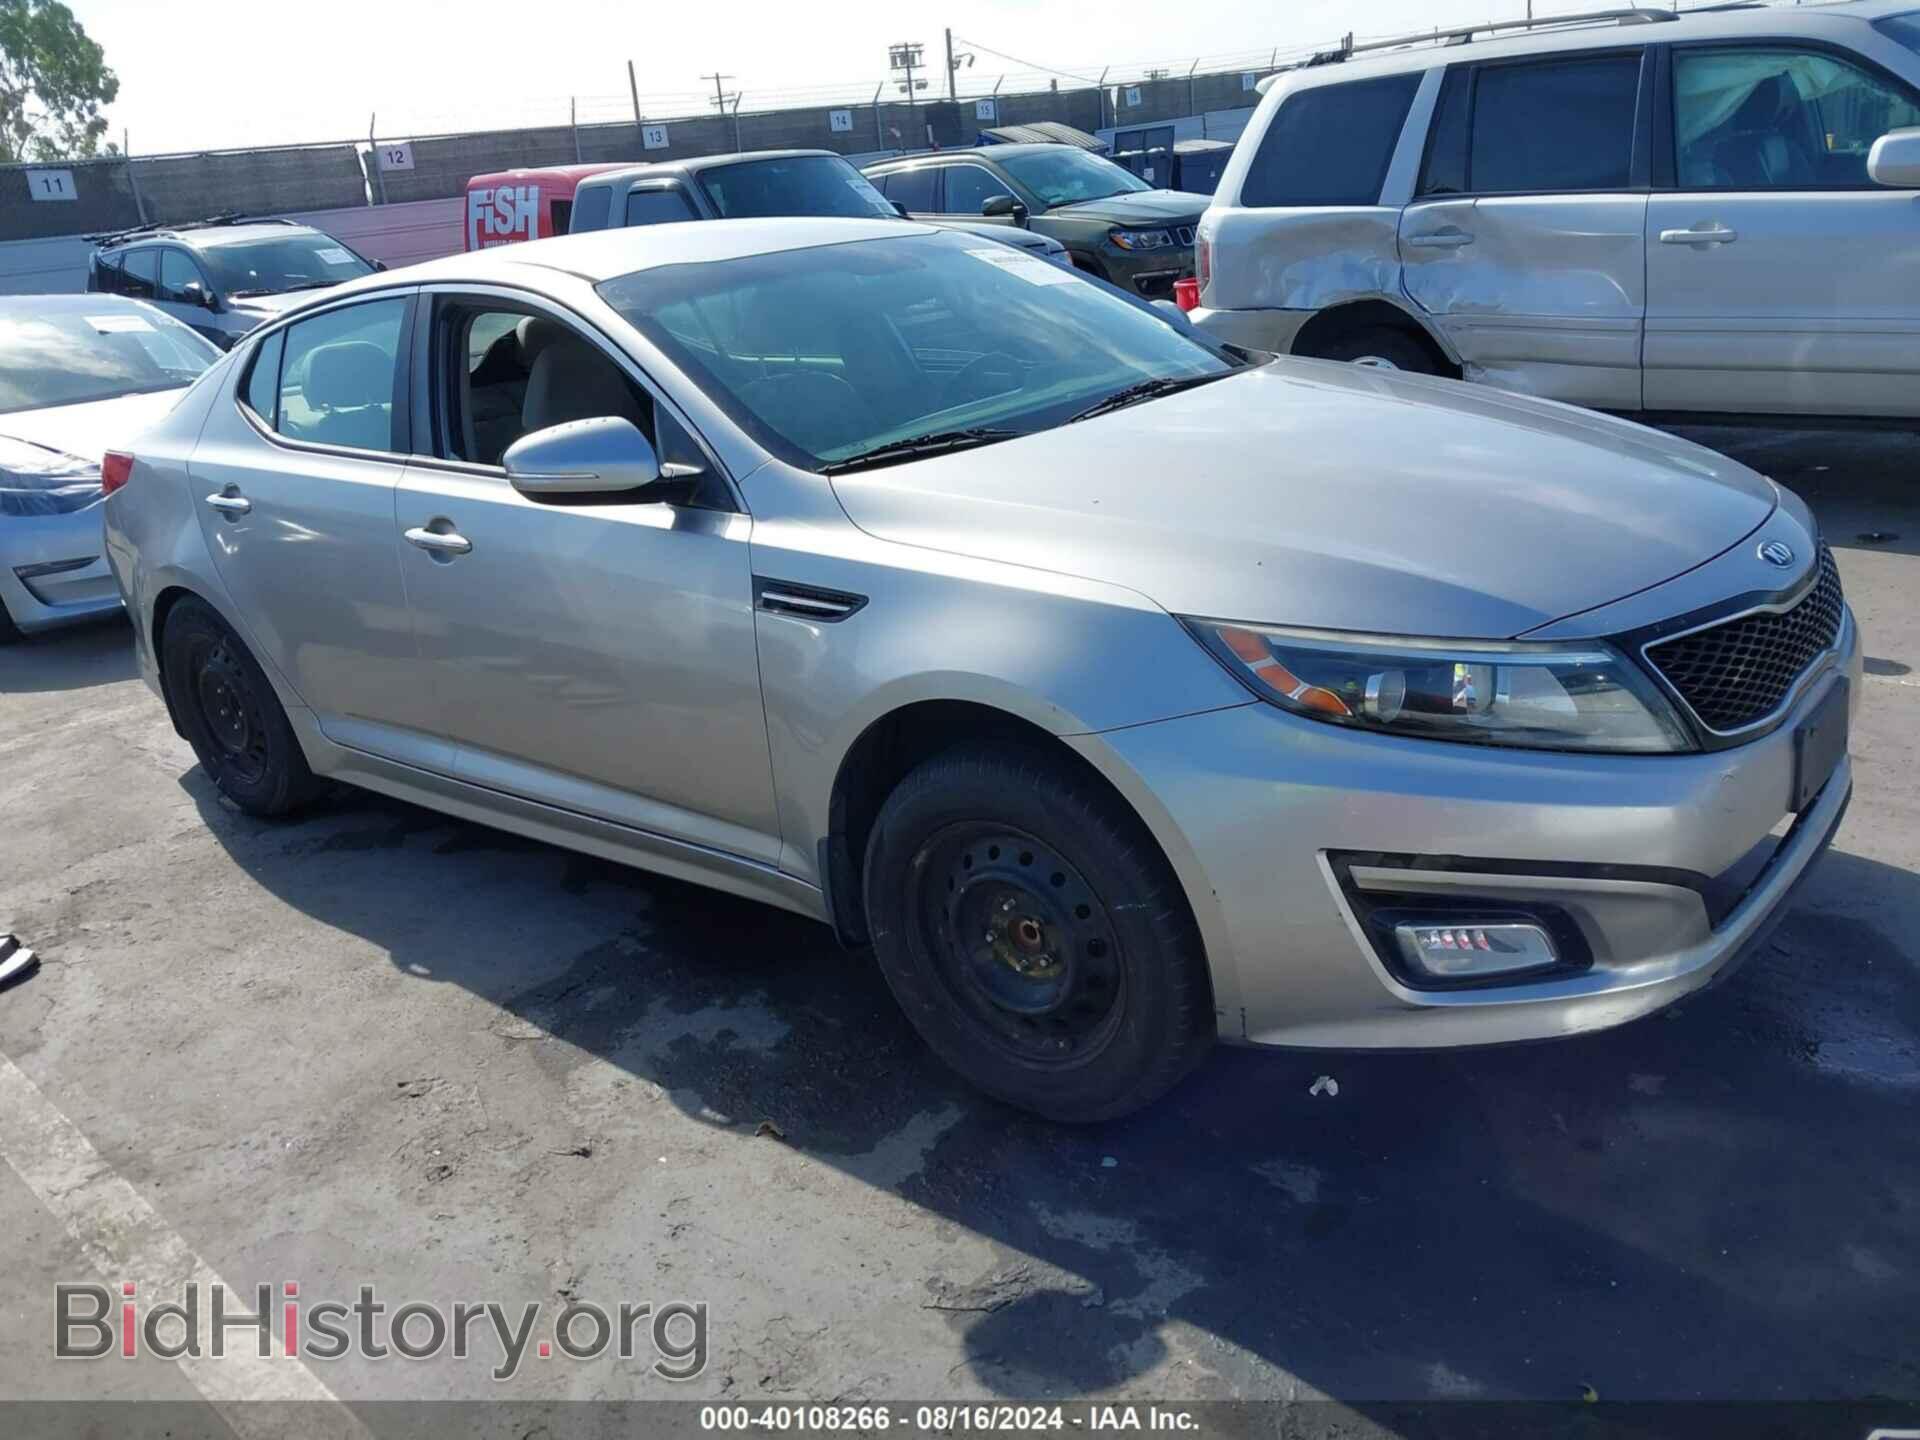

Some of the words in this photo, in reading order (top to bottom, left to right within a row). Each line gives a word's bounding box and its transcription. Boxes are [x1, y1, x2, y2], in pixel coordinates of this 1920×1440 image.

[835, 115, 847, 127] 14
[649, 130, 662, 143] 13
[386, 151, 405, 164] 12
[41, 178, 63, 193] 11
